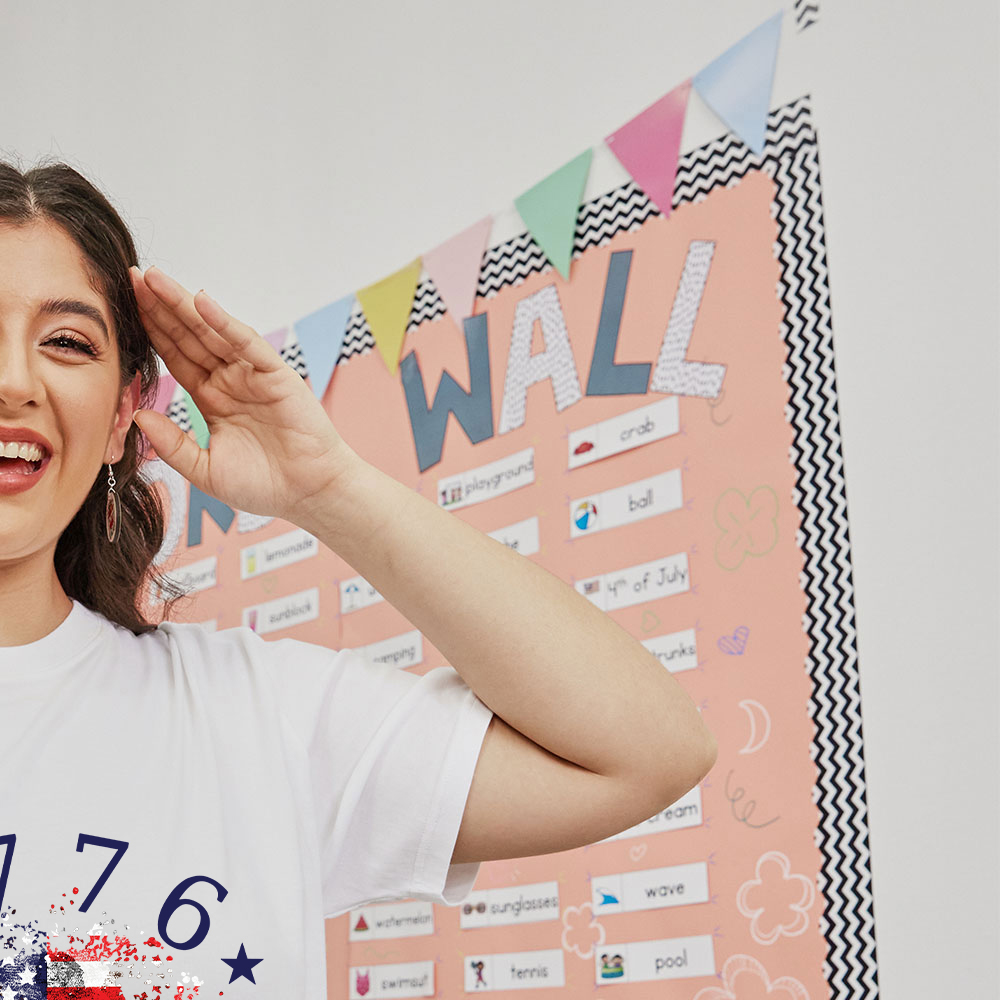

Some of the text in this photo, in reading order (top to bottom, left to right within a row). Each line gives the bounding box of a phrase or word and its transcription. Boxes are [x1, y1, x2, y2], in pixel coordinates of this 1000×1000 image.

[399, 240, 727, 474] WALL
[620, 417, 655, 441] crab
[465, 455, 534, 496] playground
[628, 488, 654, 512] ball
[633, 572, 650, 592] of
[656, 563, 687, 587] July
[645, 883, 685, 899] wave
[490, 895, 559, 917] sunglasses
[511, 966, 549, 981] tennis
[655, 948, 688, 975] pool
